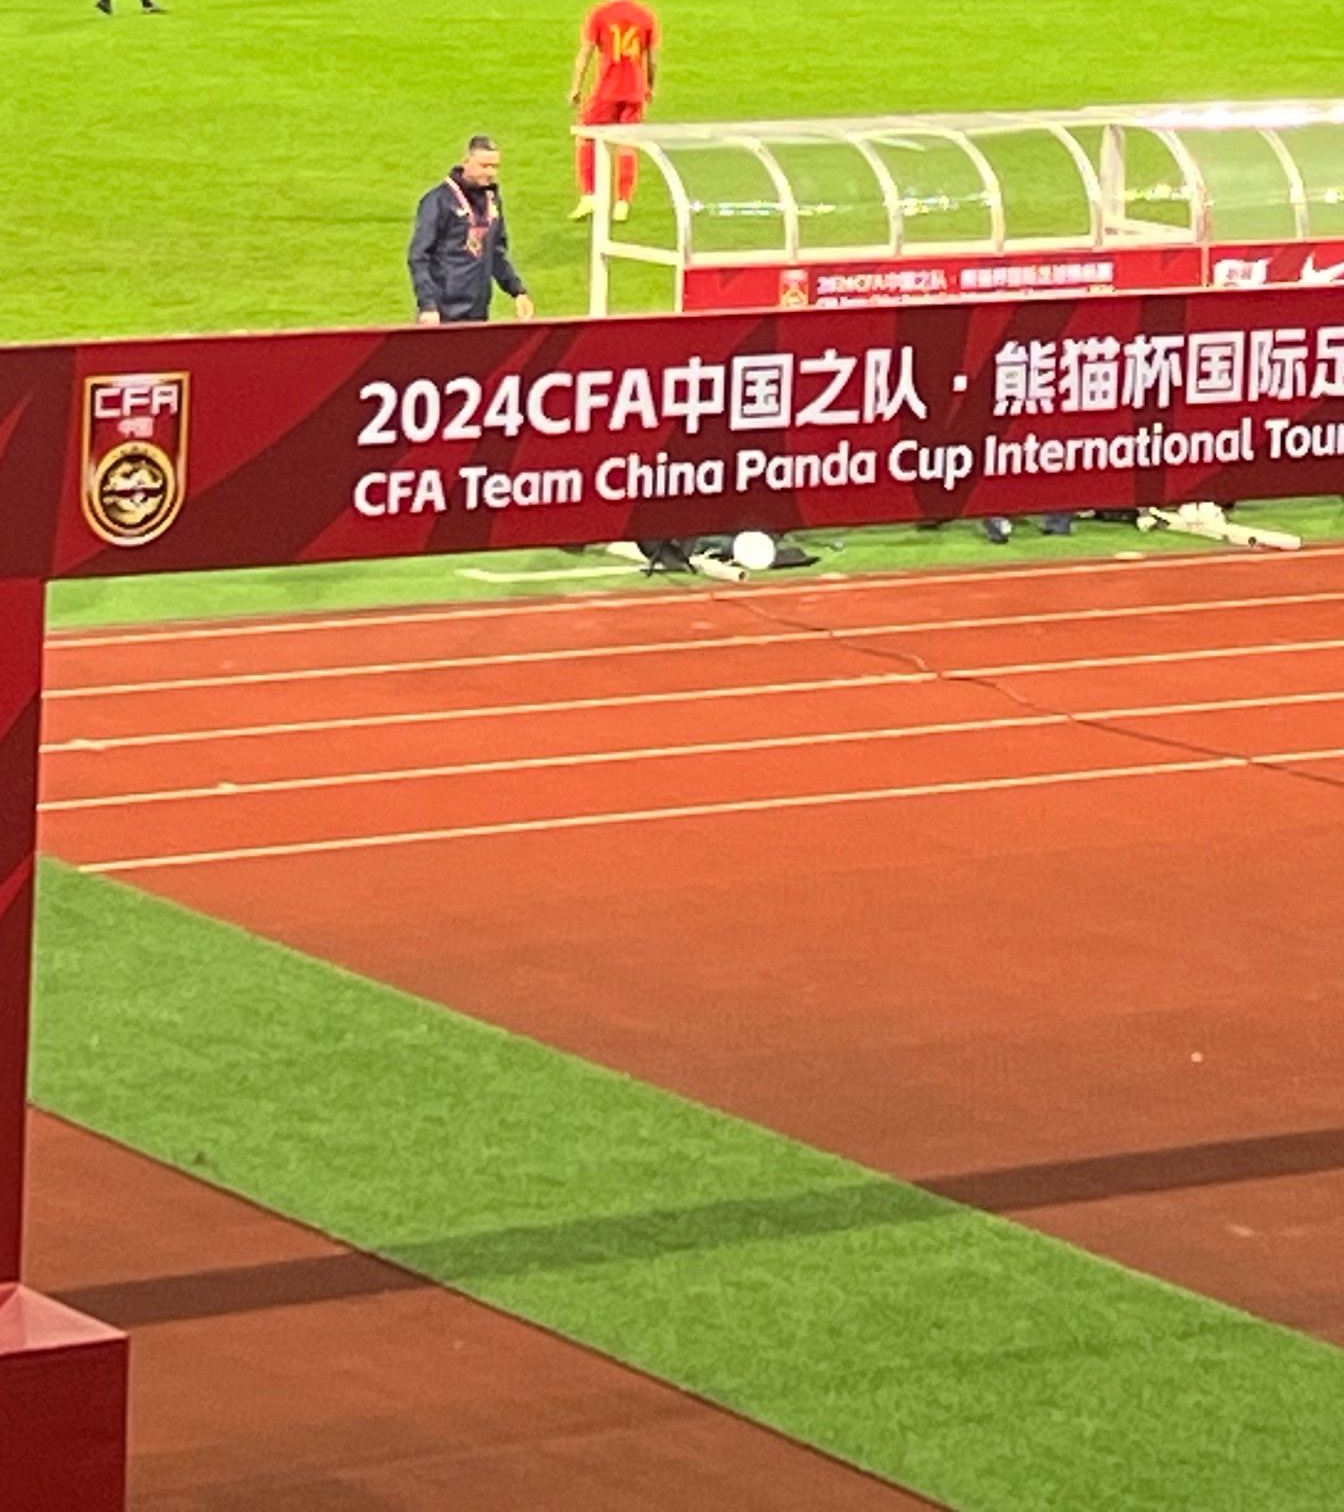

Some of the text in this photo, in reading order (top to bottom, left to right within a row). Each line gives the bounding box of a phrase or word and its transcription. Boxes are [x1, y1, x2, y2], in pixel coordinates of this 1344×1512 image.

[95, 384, 178, 419] CFA
[354, 469, 446, 516] CFA
[458, 466, 582, 509] Team
[595, 452, 725, 500] China
[736, 441, 877, 492] Panda
[888, 440, 973, 491] Cup
[984, 418, 1254, 476] International
